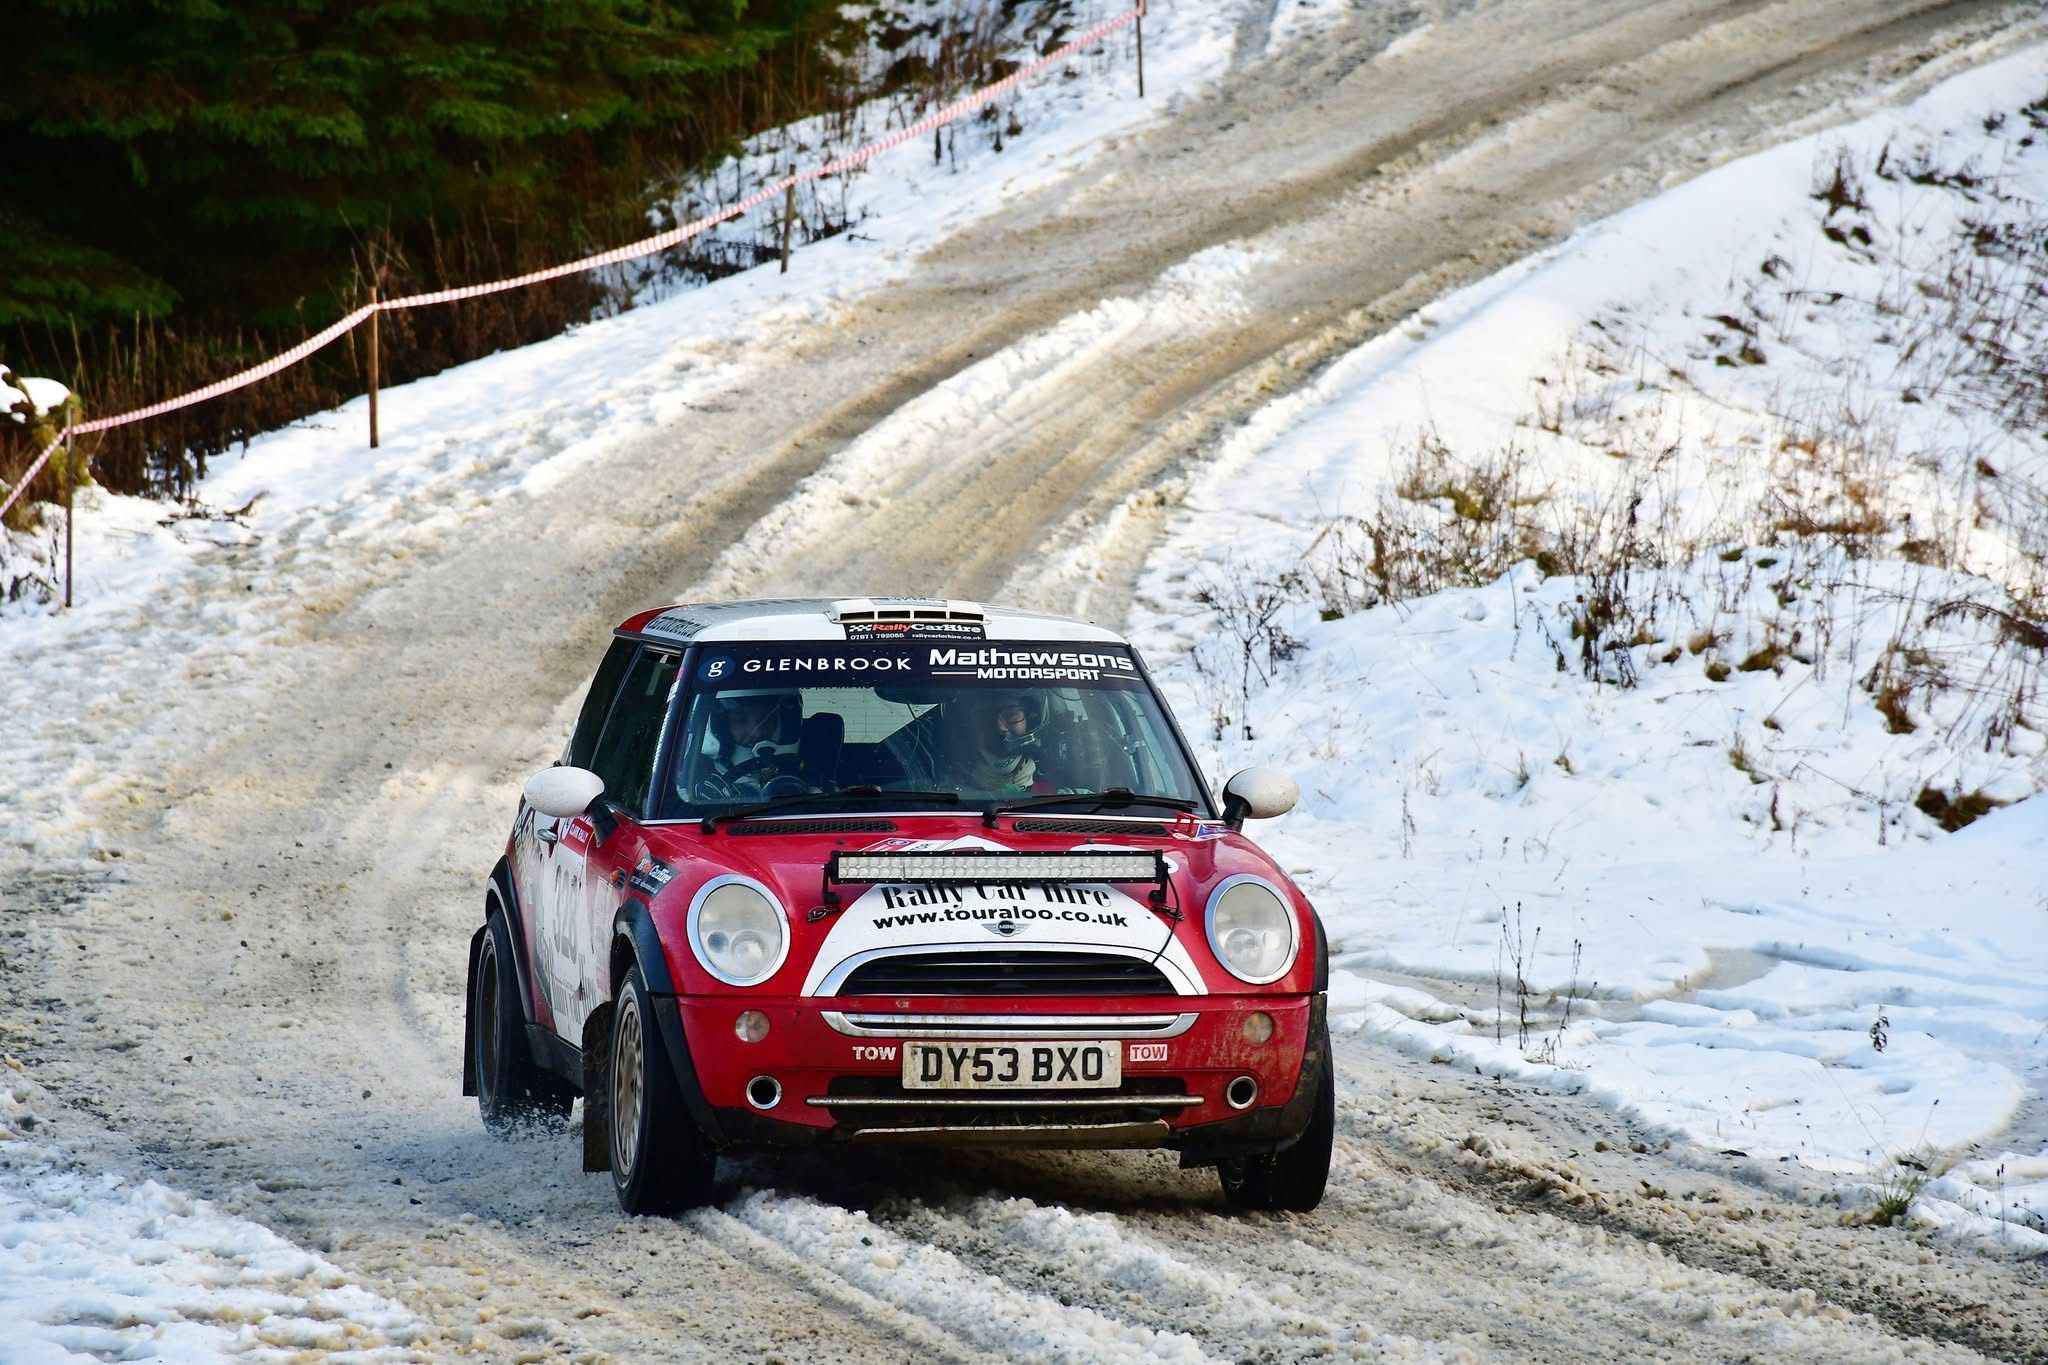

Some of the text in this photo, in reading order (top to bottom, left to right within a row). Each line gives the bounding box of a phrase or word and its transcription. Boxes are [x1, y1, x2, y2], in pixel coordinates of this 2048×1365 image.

[743, 657, 912, 673] GLENBROOK
[929, 648, 1135, 671] Mathewsons
[977, 667, 1100, 681] MOTORSPORT
[880, 884, 964, 910] Rally
[872, 906, 1129, 930] www.touraloo.co.uk
[852, 1046, 896, 1060] TOW
[1132, 1046, 1166, 1060] TOW
[920, 1046, 1104, 1082] DY53 BXO
